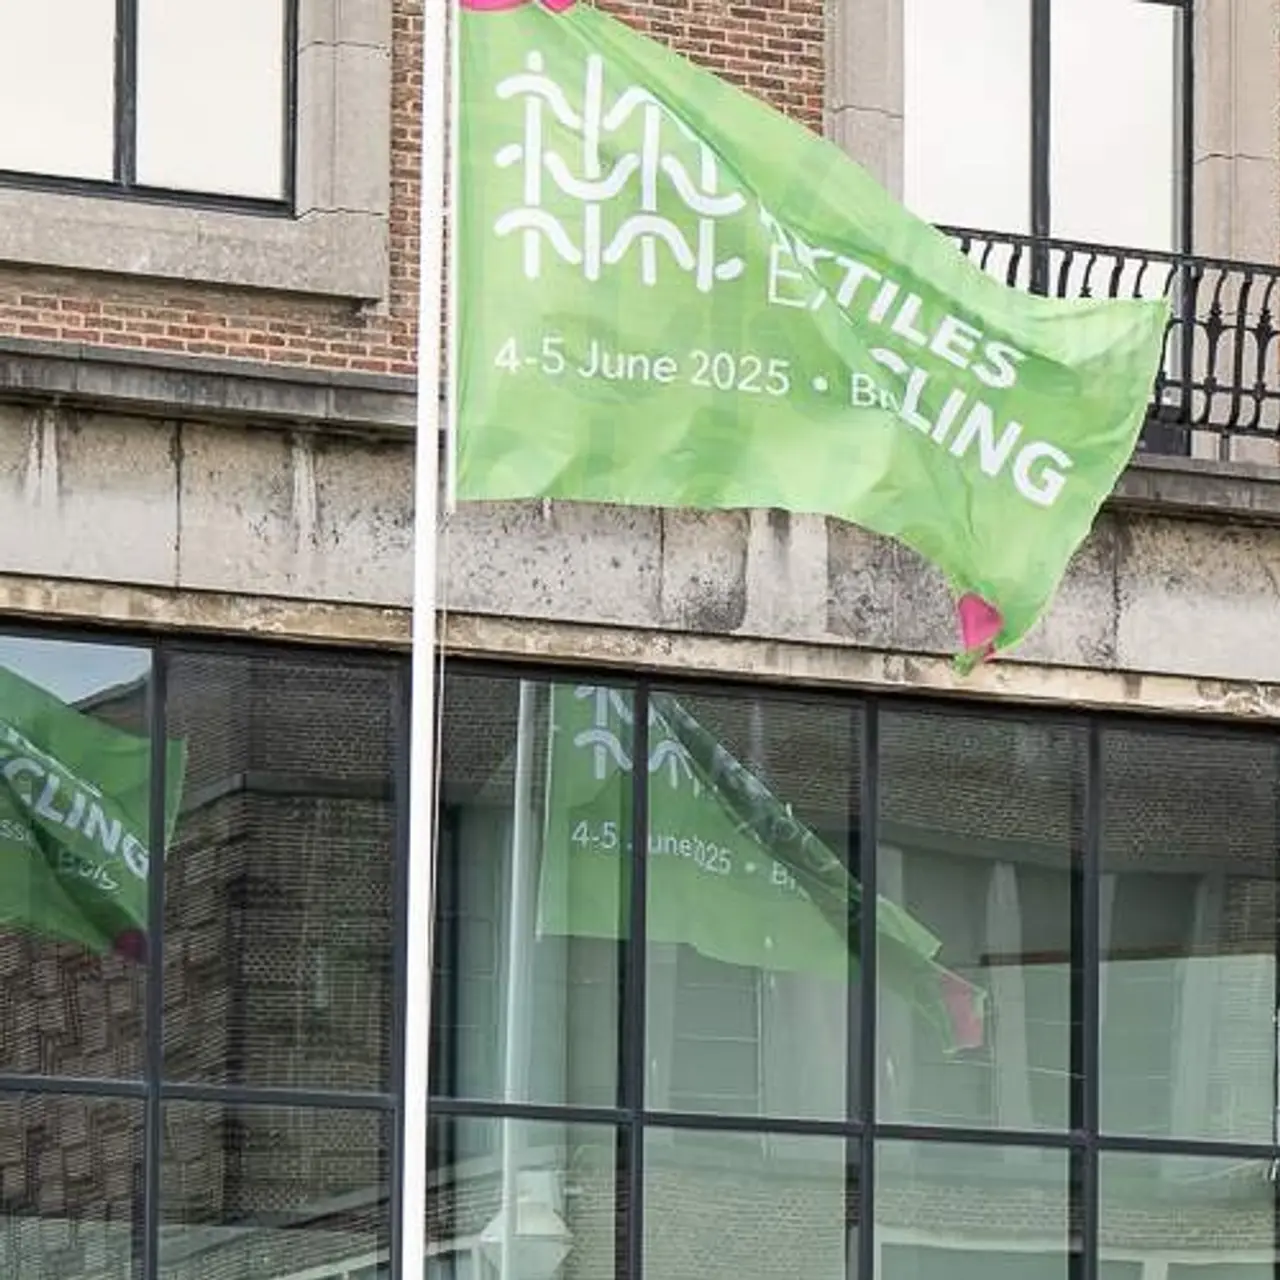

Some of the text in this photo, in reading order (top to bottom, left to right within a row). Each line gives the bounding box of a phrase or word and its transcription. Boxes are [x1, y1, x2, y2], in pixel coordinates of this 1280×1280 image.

[494, 336, 566, 375] 4-5
[577, 338, 678, 384] June
[690, 349, 791, 396] 2025
[571, 820, 618, 851] 4-5
